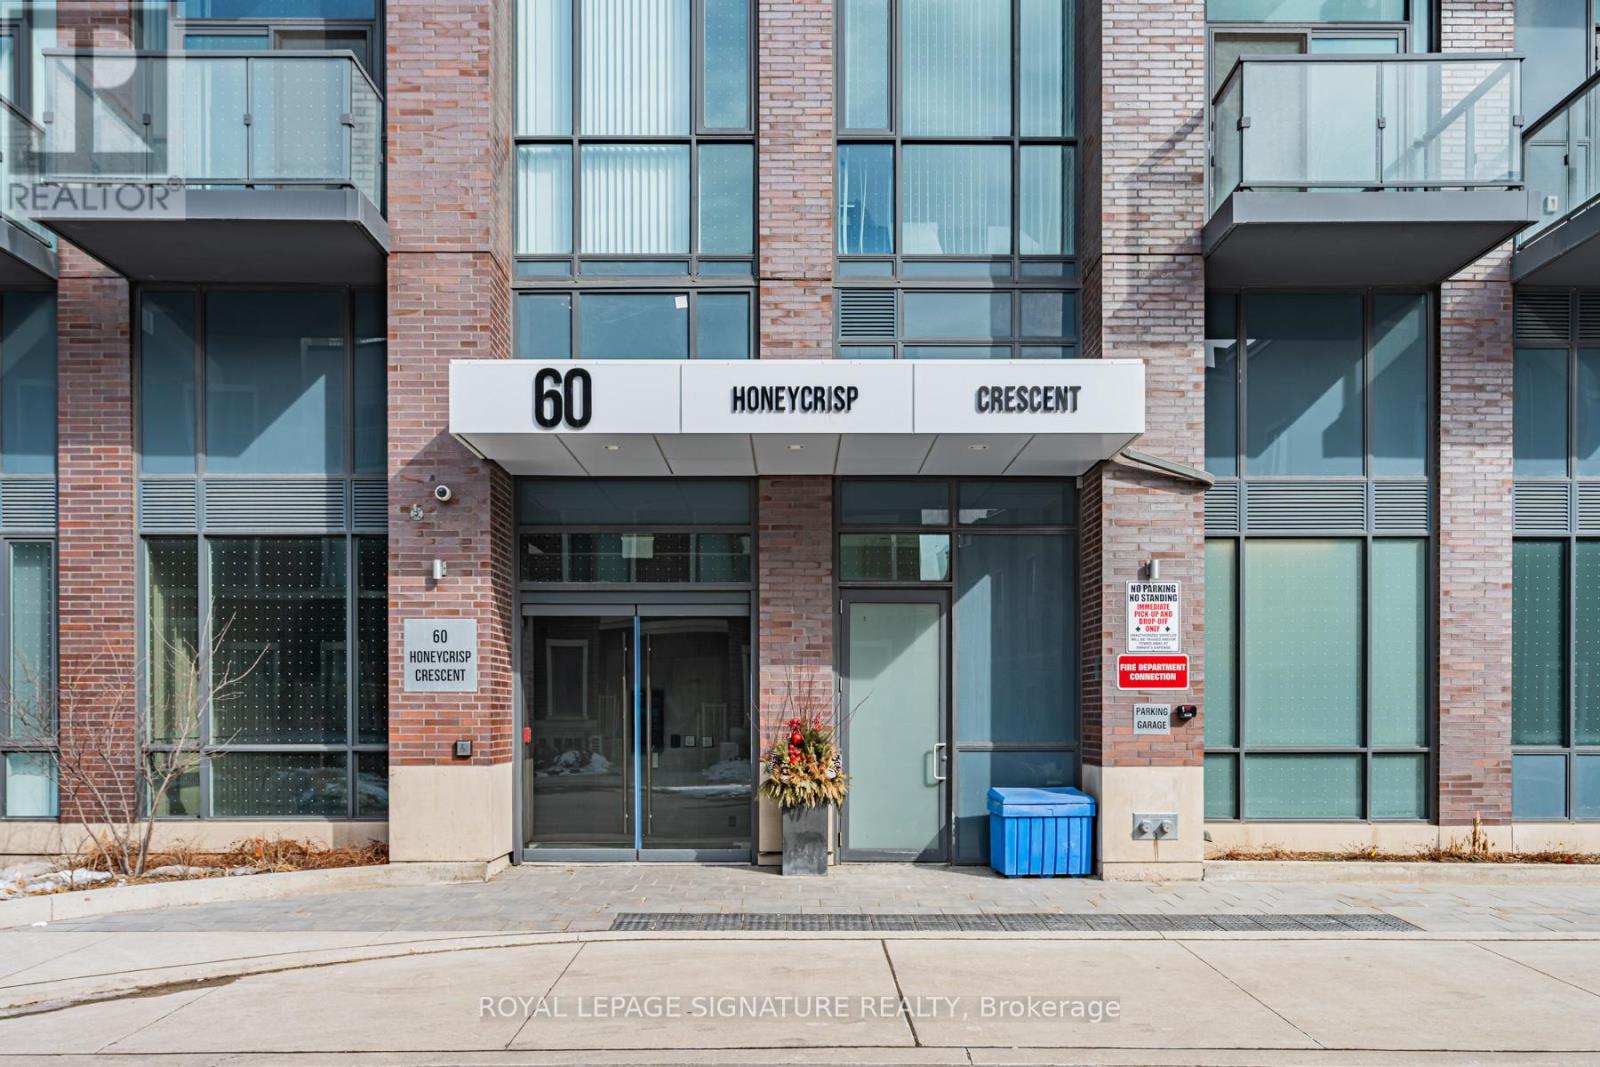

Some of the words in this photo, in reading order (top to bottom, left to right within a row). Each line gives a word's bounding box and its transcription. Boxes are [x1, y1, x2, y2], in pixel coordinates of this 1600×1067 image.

[534, 367, 592, 428] 60
[731, 385, 859, 413] HONEYCRISP
[976, 385, 1081, 413] CRESCENT
[1130, 584, 1141, 593] NO
[1143, 584, 1176, 593] PARKING
[1130, 594, 1140, 602] NO
[1141, 594, 1178, 602] STANDING
[433, 629, 448, 644] 60
[409, 650, 472, 663] HONEYCRISP
[1120, 663, 1137, 671] FIRE
[1138, 663, 1187, 671] DEPARTMENT
[415, 669, 466, 682] CRESCENT
[1135, 707, 1169, 716] PARKING
[1137, 721, 1167, 729] GARAGE
